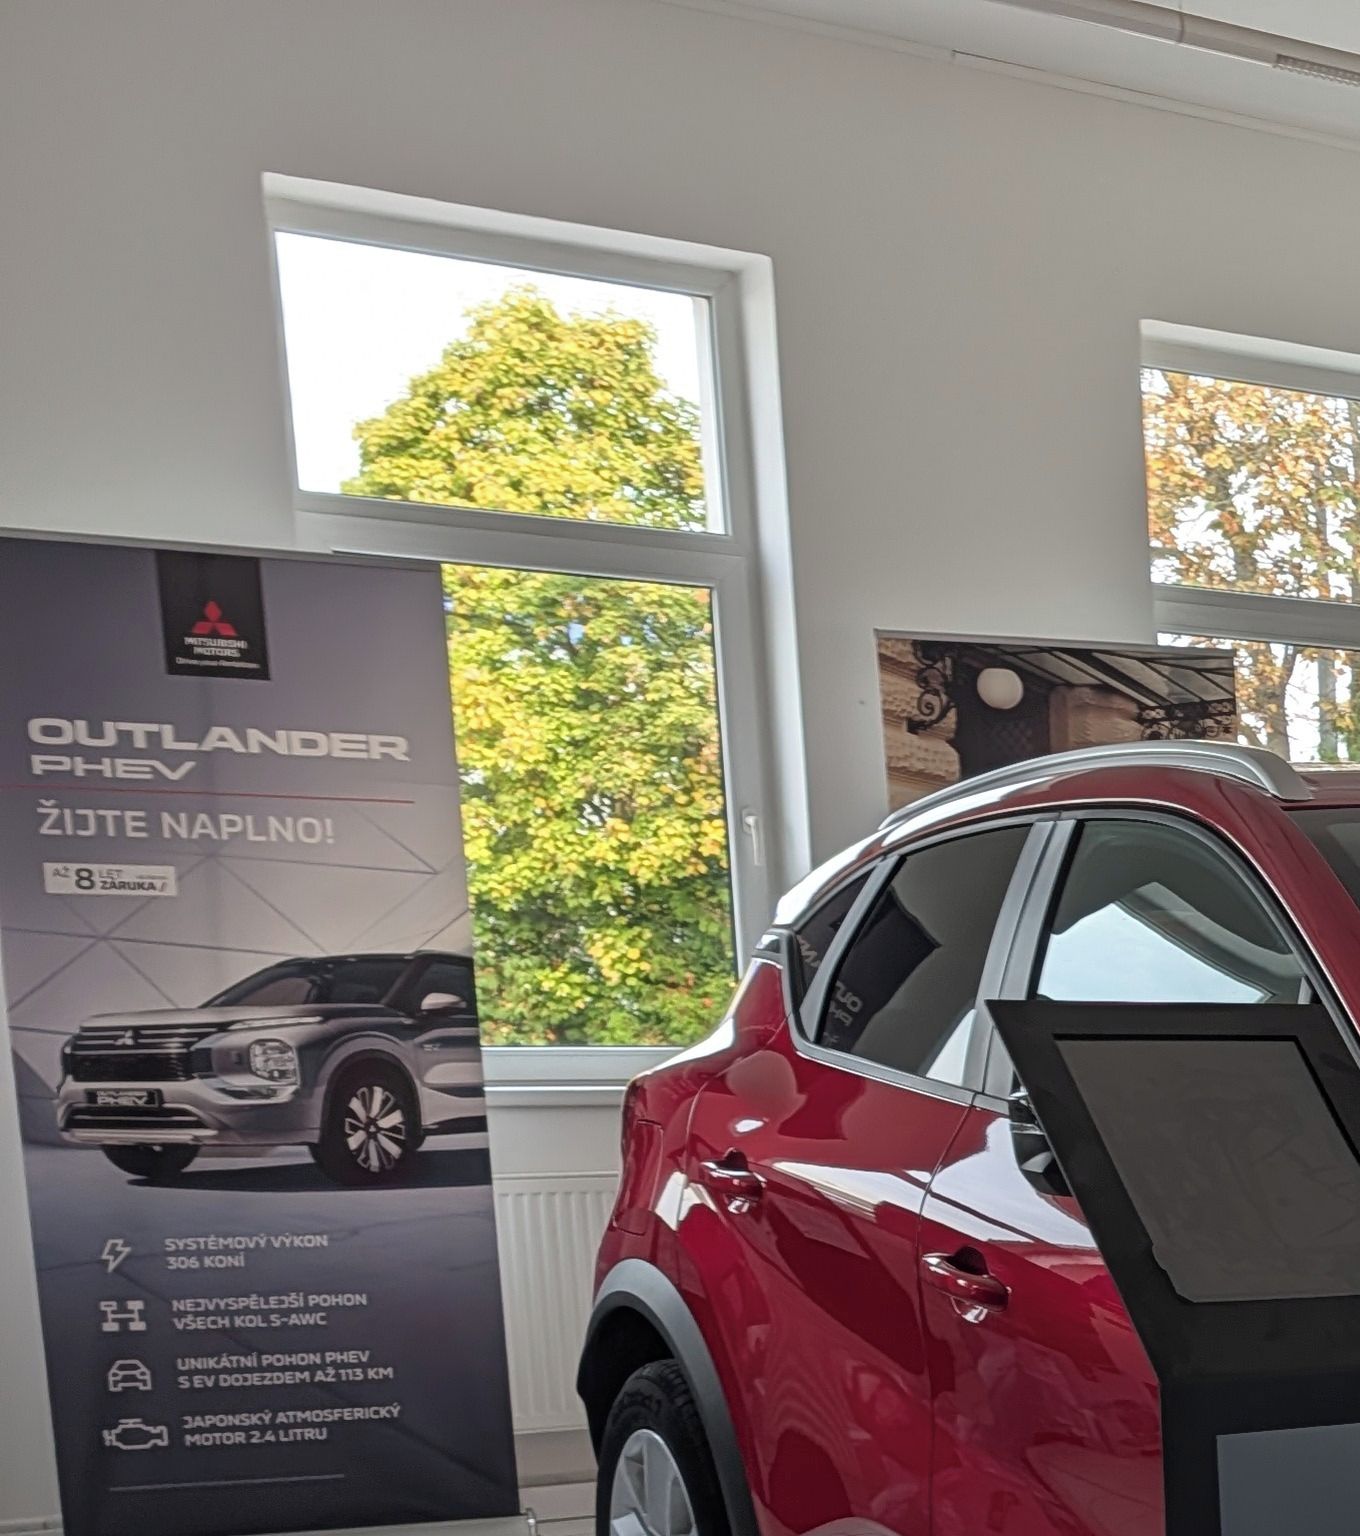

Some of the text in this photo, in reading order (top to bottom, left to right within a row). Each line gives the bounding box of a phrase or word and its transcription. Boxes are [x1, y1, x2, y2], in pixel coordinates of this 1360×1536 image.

[27, 717, 411, 761] OUTLANDER
[31, 754, 197, 781] PHEV
[36, 799, 335, 844] ŽIJTE NAPLNO!
[74, 868, 96, 891] 8
[164, 1233, 329, 1252] SYSTÉMOVÝ VÝKON
[167, 1252, 245, 1270] 306 KONÍ
[172, 1292, 368, 1312] NEJVYSPĚLEJŠÍ POHON
[172, 1312, 328, 1331] VŠECH KOL S-AWC
[176, 1350, 370, 1371] UNIKÁTNÍ POHON PHEV
[177, 1366, 393, 1389] S EV DOJEZDEM AŽ 113 KM
[181, 1402, 401, 1429] JAPONSKÝ ATMOSFERICKÝ
[184, 1427, 328, 1447] MOTOR 2.4 LITRU
